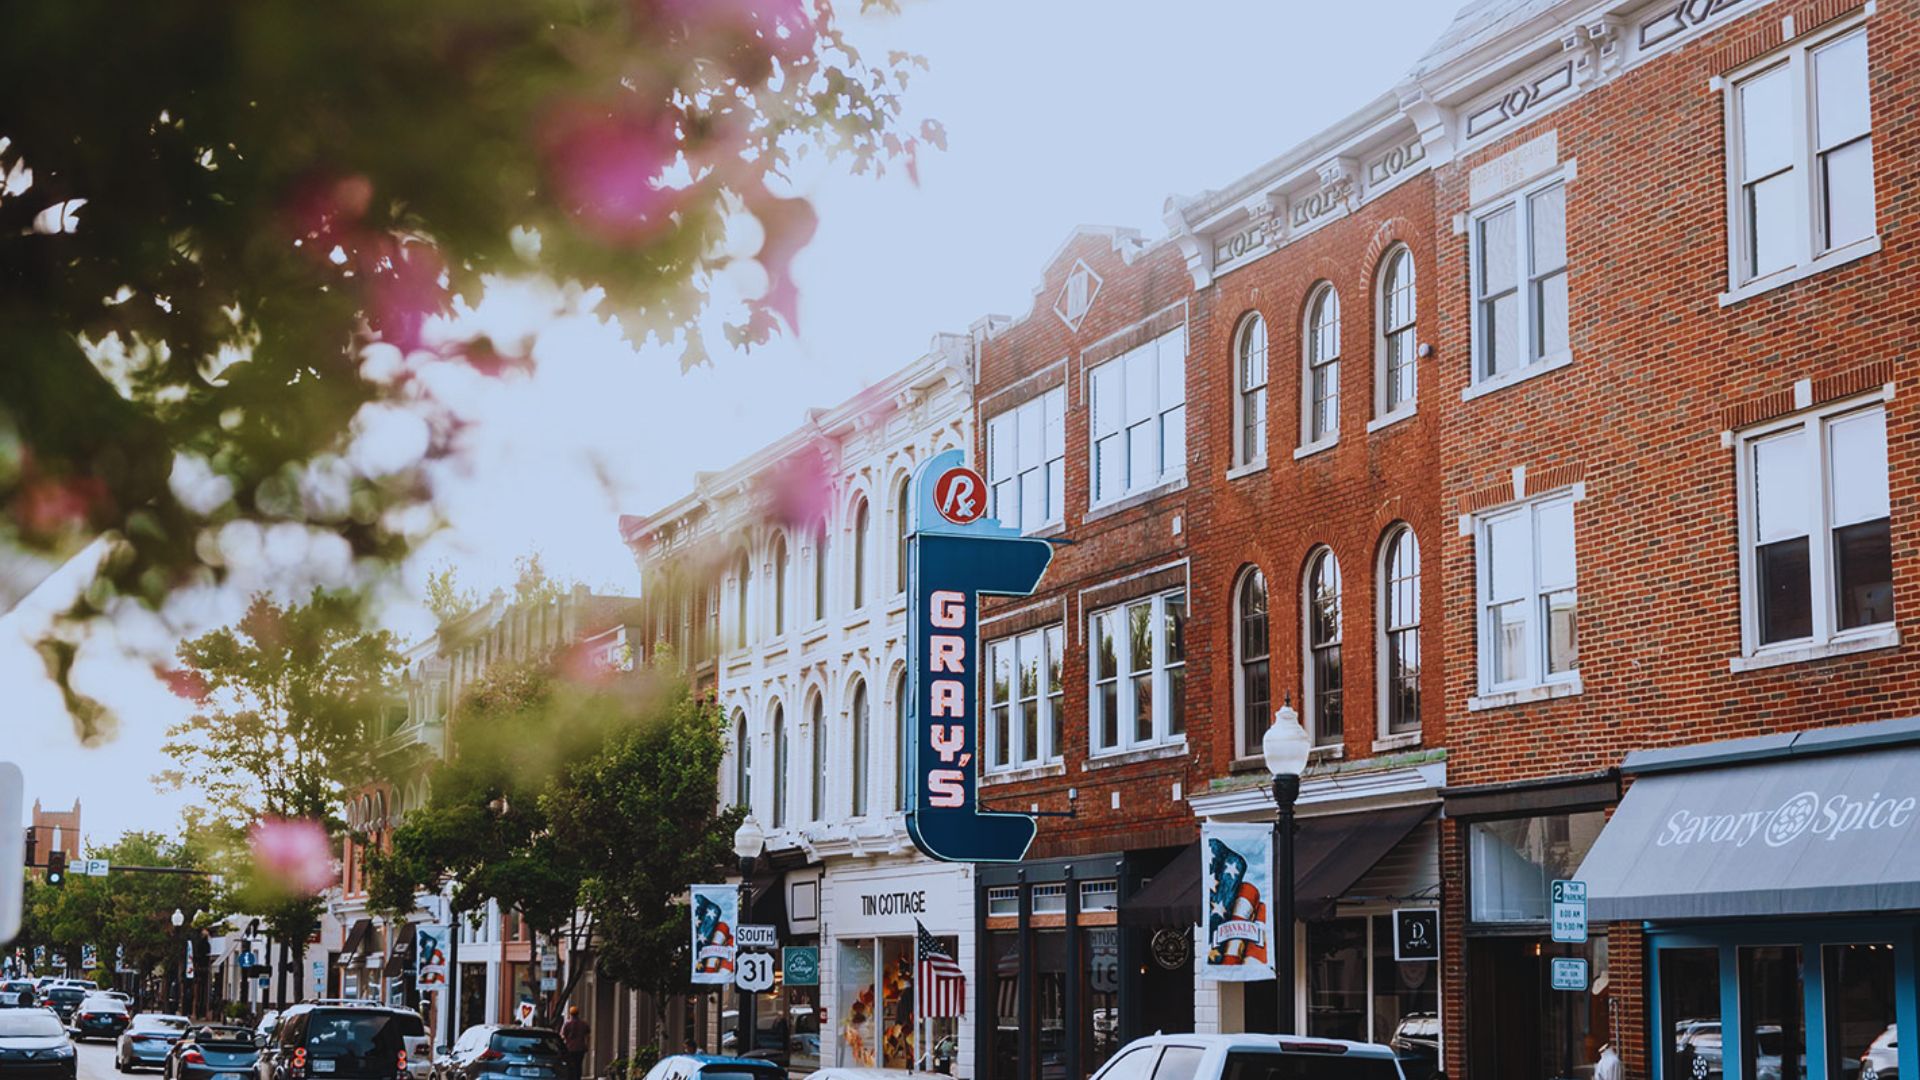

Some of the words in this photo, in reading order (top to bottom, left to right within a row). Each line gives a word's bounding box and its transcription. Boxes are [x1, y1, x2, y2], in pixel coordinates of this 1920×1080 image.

[928, 590, 971, 808] GRAY'S
[1656, 809, 1774, 848] Savory
[1811, 792, 1916, 841] Spice
[1554, 884, 1562, 900] 2
[861, 895, 877, 916] TIN
[878, 890, 926, 915] COTTAGE
[1572, 910, 1580, 918] AM
[1218, 923, 1258, 936] FRANKLIN
[1576, 922, 1584, 930] PM
[738, 929, 773, 942] SOUTH
[743, 960, 766, 982] 31
